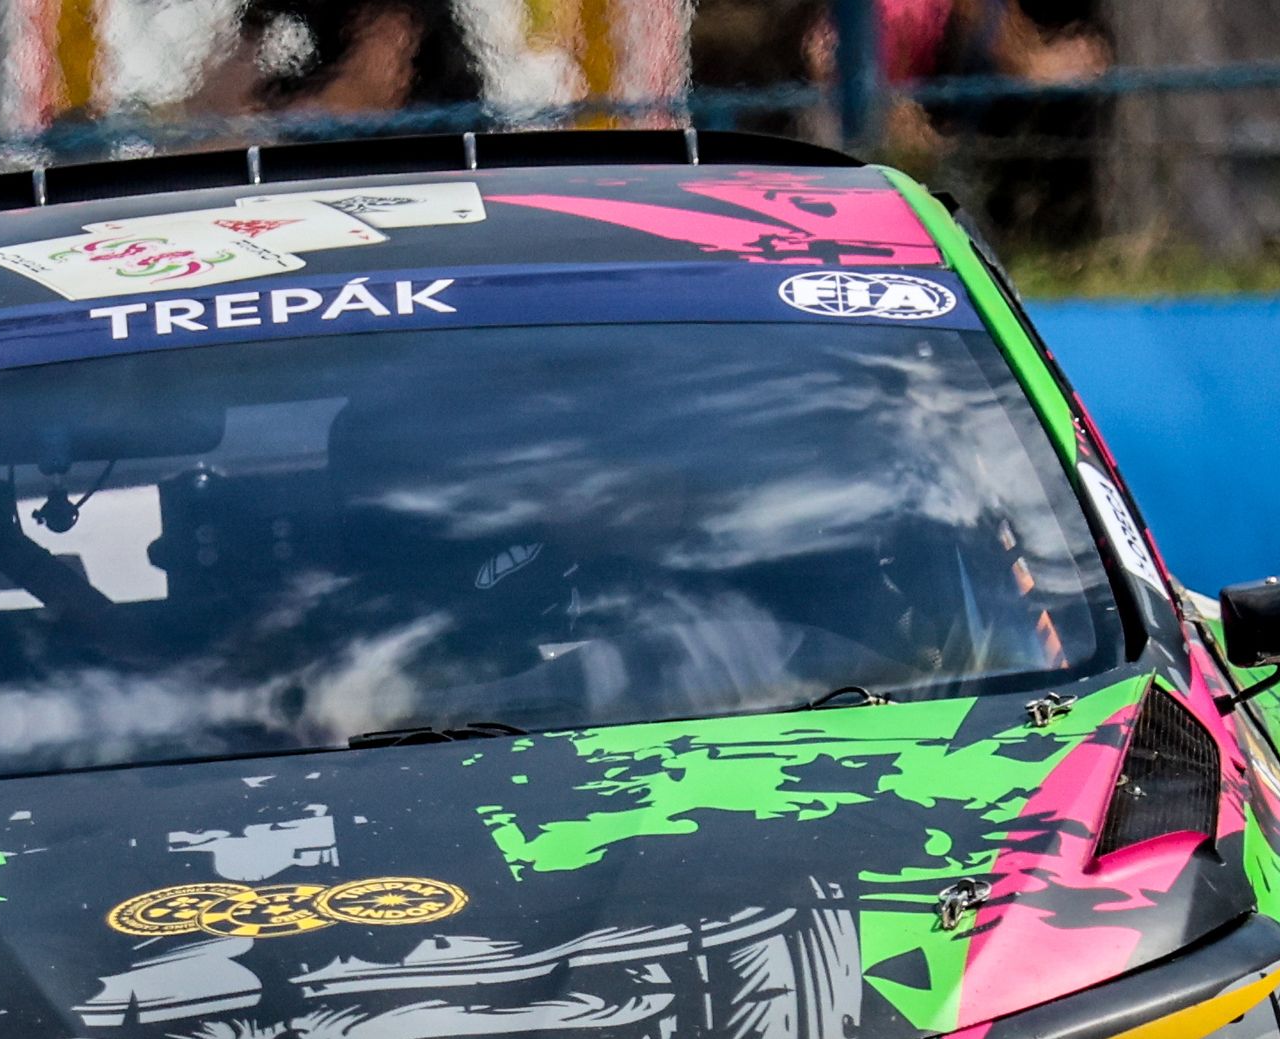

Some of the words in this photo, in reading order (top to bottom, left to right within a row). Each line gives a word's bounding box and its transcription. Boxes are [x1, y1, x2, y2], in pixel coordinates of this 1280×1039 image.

[90, 277, 458, 340] TREPÁK
[789, 276, 942, 314] FIA
[338, 902, 446, 919] ANDOR
